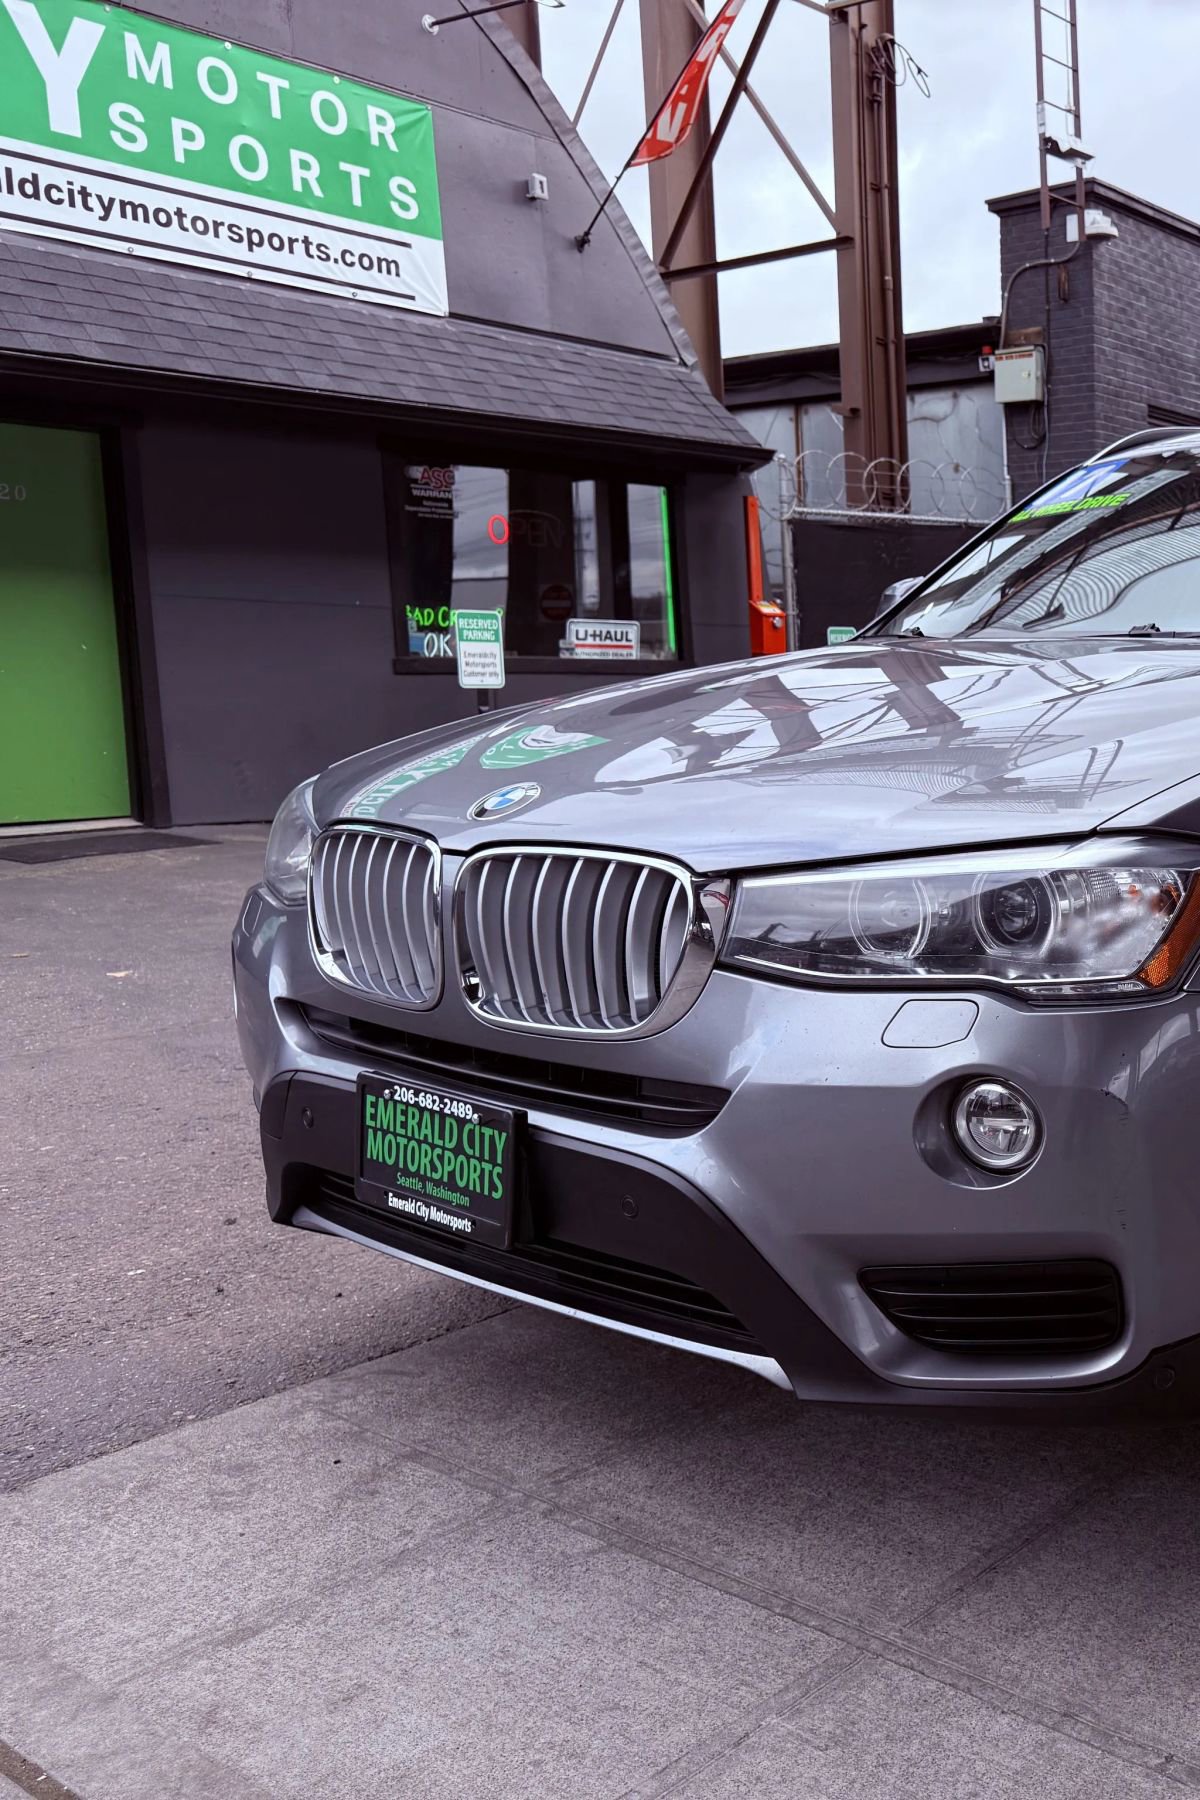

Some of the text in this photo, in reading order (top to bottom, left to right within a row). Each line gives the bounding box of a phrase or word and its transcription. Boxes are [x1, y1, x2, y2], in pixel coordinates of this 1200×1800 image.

[124, 31, 398, 152] MOTOR
[108, 102, 419, 220] SPORTS
[0, 166, 400, 278] ldcitymotorsports.com
[412, 487, 456, 500] WARRAN
[1072, 493, 1132, 511] DRIVE
[459, 618, 498, 630] RESERVED
[463, 629, 496, 641] PARKING
[424, 632, 453, 658] OK
[393, 1085, 473, 1120] 206-682-2489
[365, 1094, 507, 1165] EMERALD CITY
[366, 1128, 503, 1200] MOTORSPORTS
[396, 1171, 470, 1207] Seattle, Washington
[388, 1191, 472, 1233] Emerald City Motorsports
